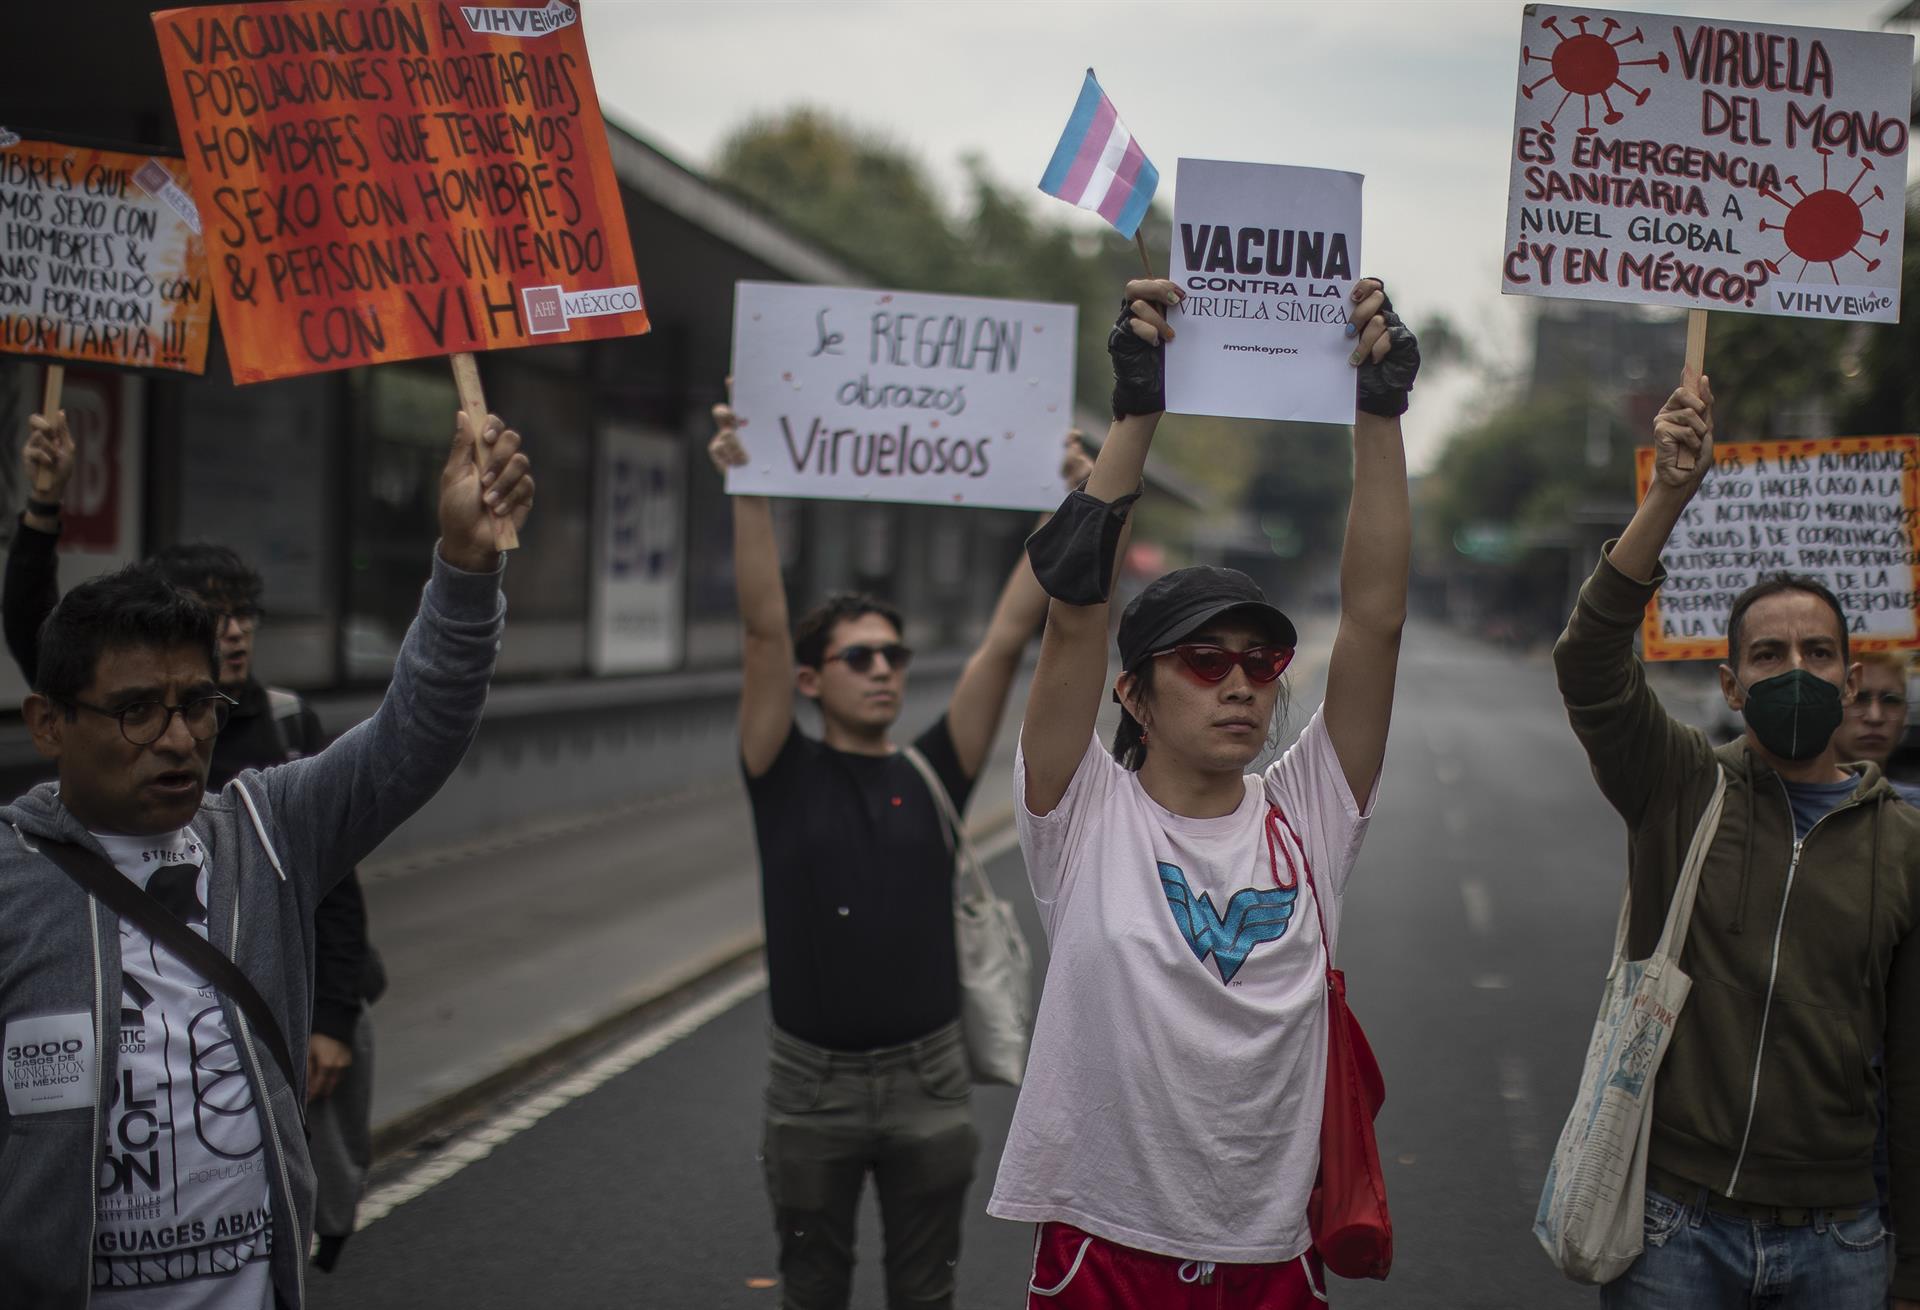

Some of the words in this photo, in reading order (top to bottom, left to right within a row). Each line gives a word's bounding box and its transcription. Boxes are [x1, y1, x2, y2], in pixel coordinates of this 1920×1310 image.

[170, 2, 430, 64] VACUNACIÓN
[438, 5, 466, 50] A
[463, 7, 577, 33] VIHVElibre
[1672, 23, 1834, 100] VIRUELA
[182, 58, 394, 121] POBLACIONES
[399, 51, 582, 116] PRIORITARIAS
[195, 114, 371, 180] HOMBRES
[376, 112, 440, 165] QUE
[432, 112, 577, 165] TENEMOS
[1701, 88, 1772, 148] DEL
[1785, 99, 1909, 159] MONO
[1516, 126, 1556, 165] ES
[1571, 132, 1783, 192] EMERGENCIA
[213, 182, 322, 249] SEXO
[334, 184, 410, 229] CON
[413, 161, 583, 231] HOMBRES
[1524, 165, 1711, 218] SANITARIA
[1721, 193, 1745, 222] A
[50, 194, 107, 230] SEXO
[113, 204, 158, 242] CON
[1519, 206, 1613, 241] NIVEL
[1627, 215, 1742, 256] GLOBAL
[7, 223, 116, 270] HOMBRES
[126, 238, 147, 273] &
[225, 253, 261, 308] &
[267, 229, 441, 303] PERSONAS
[444, 222, 605, 281] VIVIENDO
[1180, 223, 1352, 281] VACUNA
[48, 261, 154, 298] VIVIENDO
[159, 276, 203, 306] CON
[1187, 276, 1298, 297] CONTRA
[1308, 283, 1341, 299] LA
[1503, 233, 1557, 286] ¿Y
[1562, 246, 1610, 285] EN
[1617, 250, 1771, 309] MÉXICO?
[301, 304, 388, 364] CON
[405, 283, 526, 348] VIH
[535, 300, 557, 318] AHF
[563, 291, 638, 317] MÉXICO
[1178, 295, 1270, 321] VIRUELA
[1276, 299, 1350, 326] SÍMICA
[1776, 289, 1893, 316] VIHVElibre
[808, 306, 846, 358] Se
[869, 309, 1024, 374] REGALAN
[1222, 343, 1299, 356] #monkeypox
[836, 372, 968, 417] abrazos
[779, 415, 992, 479] Viruelosos
[1755, 456, 1768, 476] A
[1778, 454, 1811, 475] LAS
[1815, 477, 1857, 497] CASO
[1861, 477, 1874, 496] A
[1878, 476, 1901, 497] LA
[1765, 525, 1791, 546] DE
[1663, 575, 1713, 592] ODOS
[1715, 572, 1748, 590] LOS
[1835, 572, 1860, 590] DE
[1865, 570, 1889, 589] LA
[1663, 620, 1676, 638] A
[1681, 619, 1706, 637] LA
[142, 849, 186, 862] STREET
[7, 1039, 83, 1061] 3000
[7, 1060, 86, 1082] MONKEYPOX
[13, 1057, 54, 1069] CASOS
[58, 1053, 76, 1063] DE
[14, 1081, 29, 1090] EN
[32, 1074, 80, 1087] MÉXICO
[188, 1162, 254, 1185] POPULAR
[128, 1208, 161, 1221] RULES
